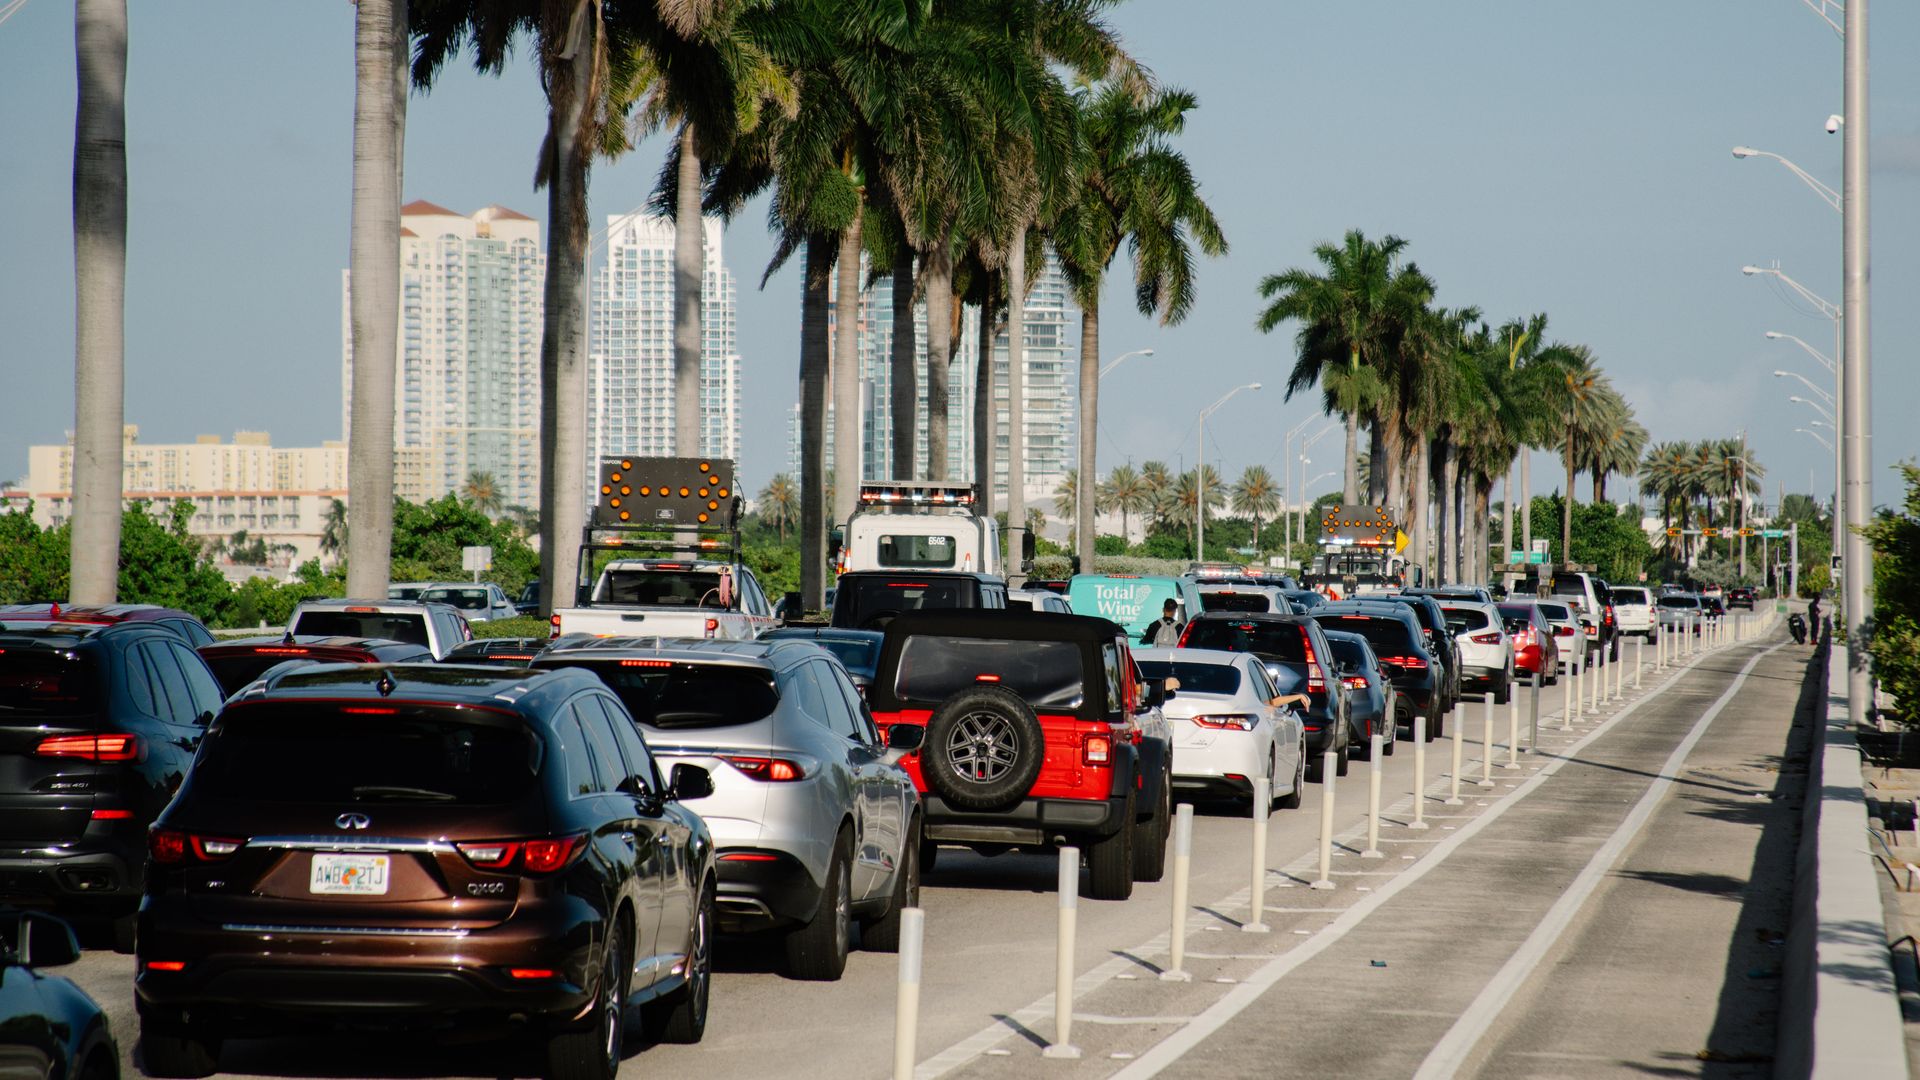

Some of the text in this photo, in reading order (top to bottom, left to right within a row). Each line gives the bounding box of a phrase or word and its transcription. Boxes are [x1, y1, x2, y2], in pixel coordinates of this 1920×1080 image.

[1094, 584, 1135, 600] Total
[1097, 600, 1141, 616] Wine
[357, 866, 383, 885] 2TJ
[467, 882, 504, 895] QX60
